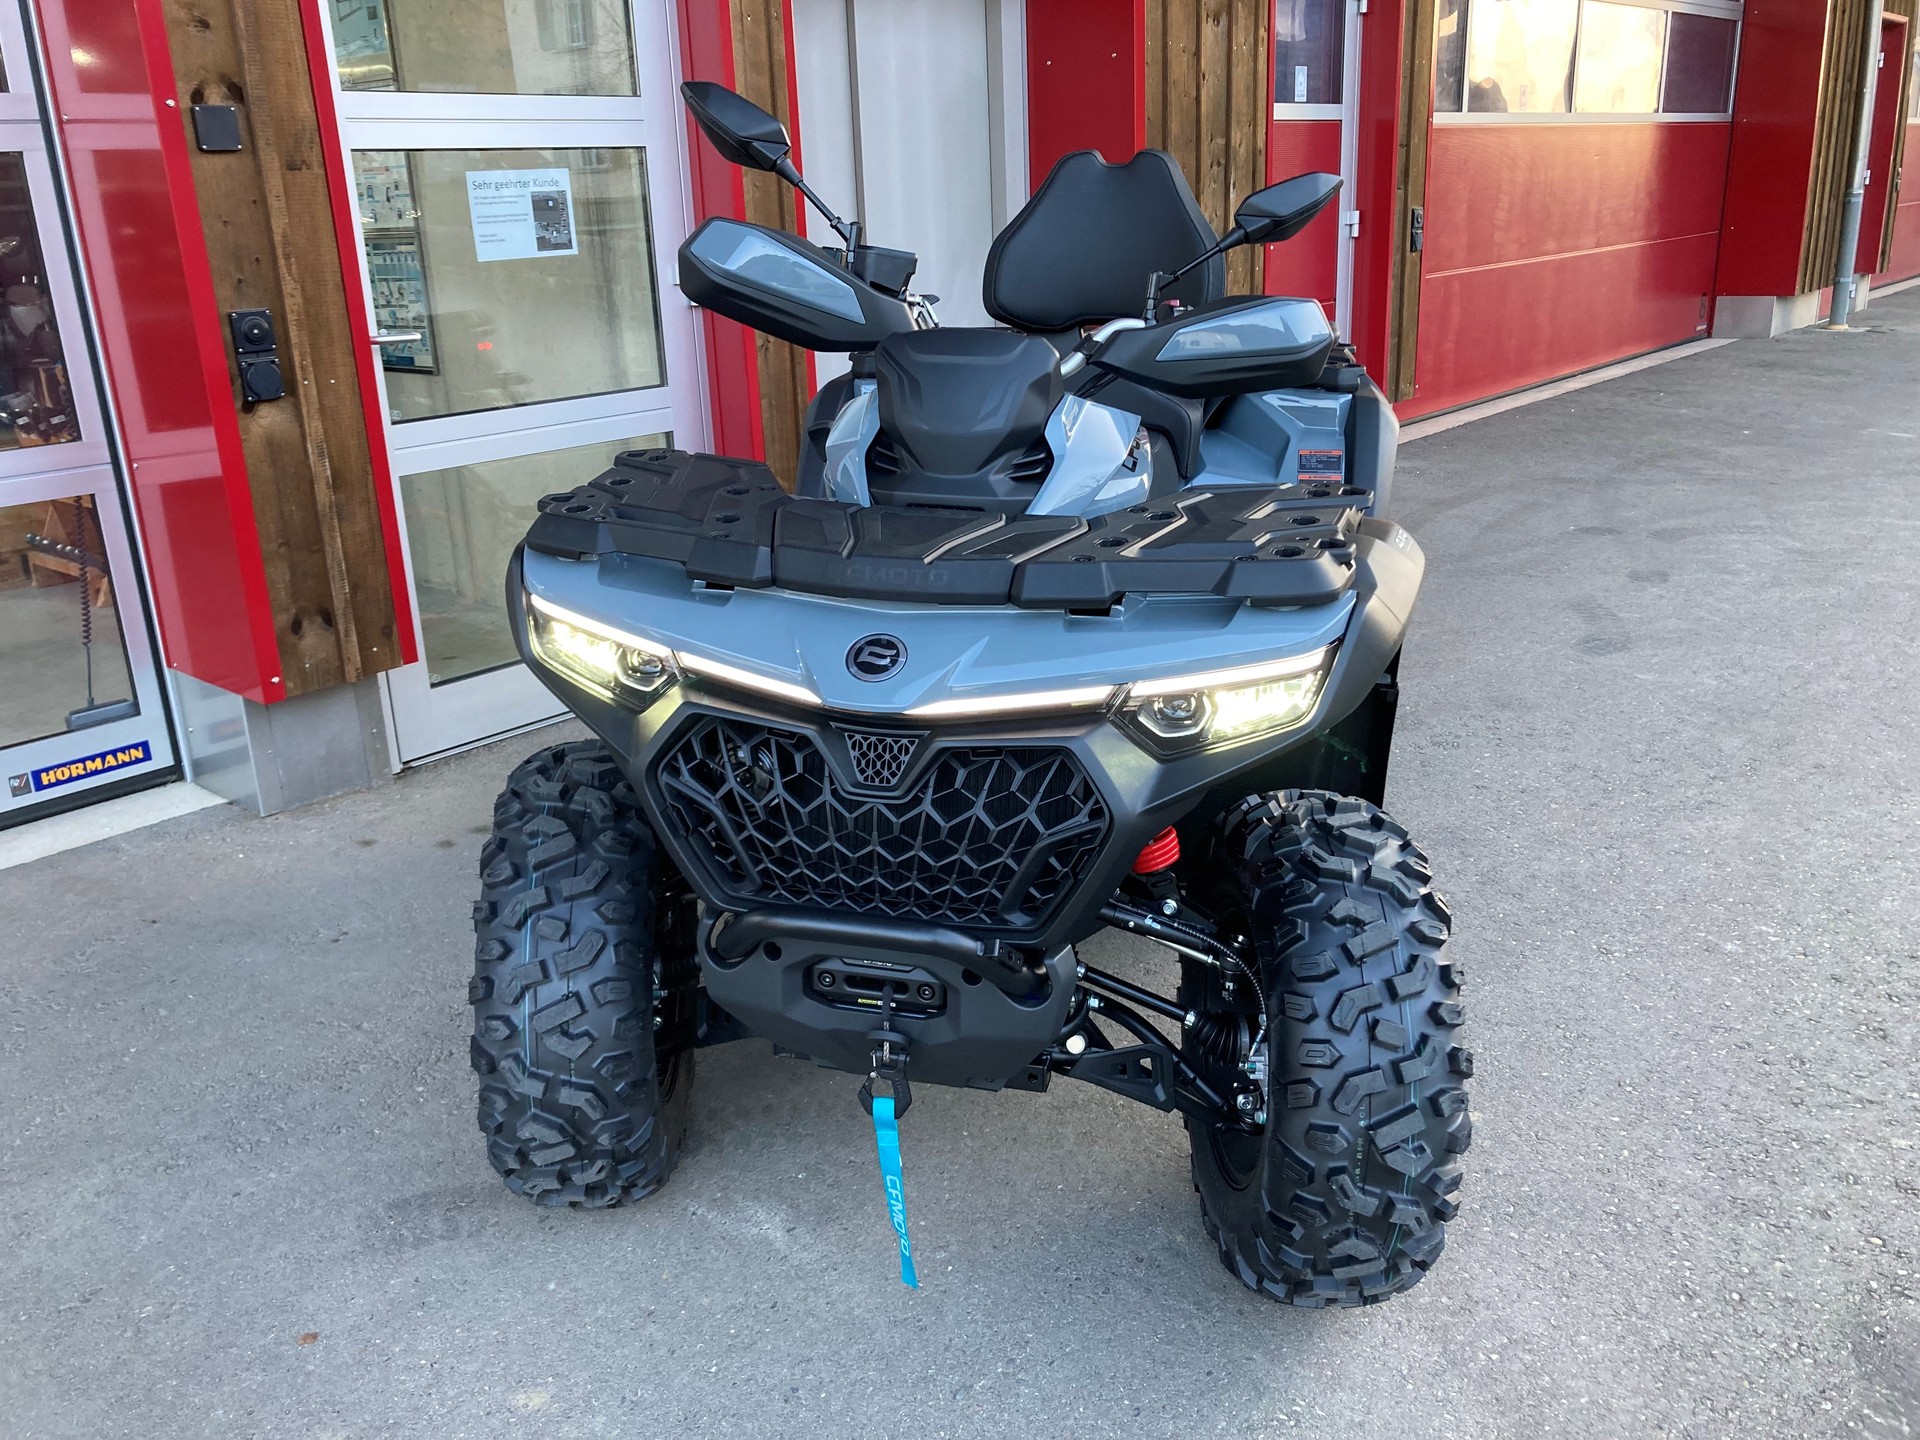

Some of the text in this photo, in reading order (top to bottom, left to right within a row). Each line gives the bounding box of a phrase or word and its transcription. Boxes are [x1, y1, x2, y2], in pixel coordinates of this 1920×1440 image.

[472, 177, 559, 192] Sehr geehrter Kunde
[40, 746, 144, 786] HÖRMANN
[885, 1174, 910, 1257] CFMOTO
